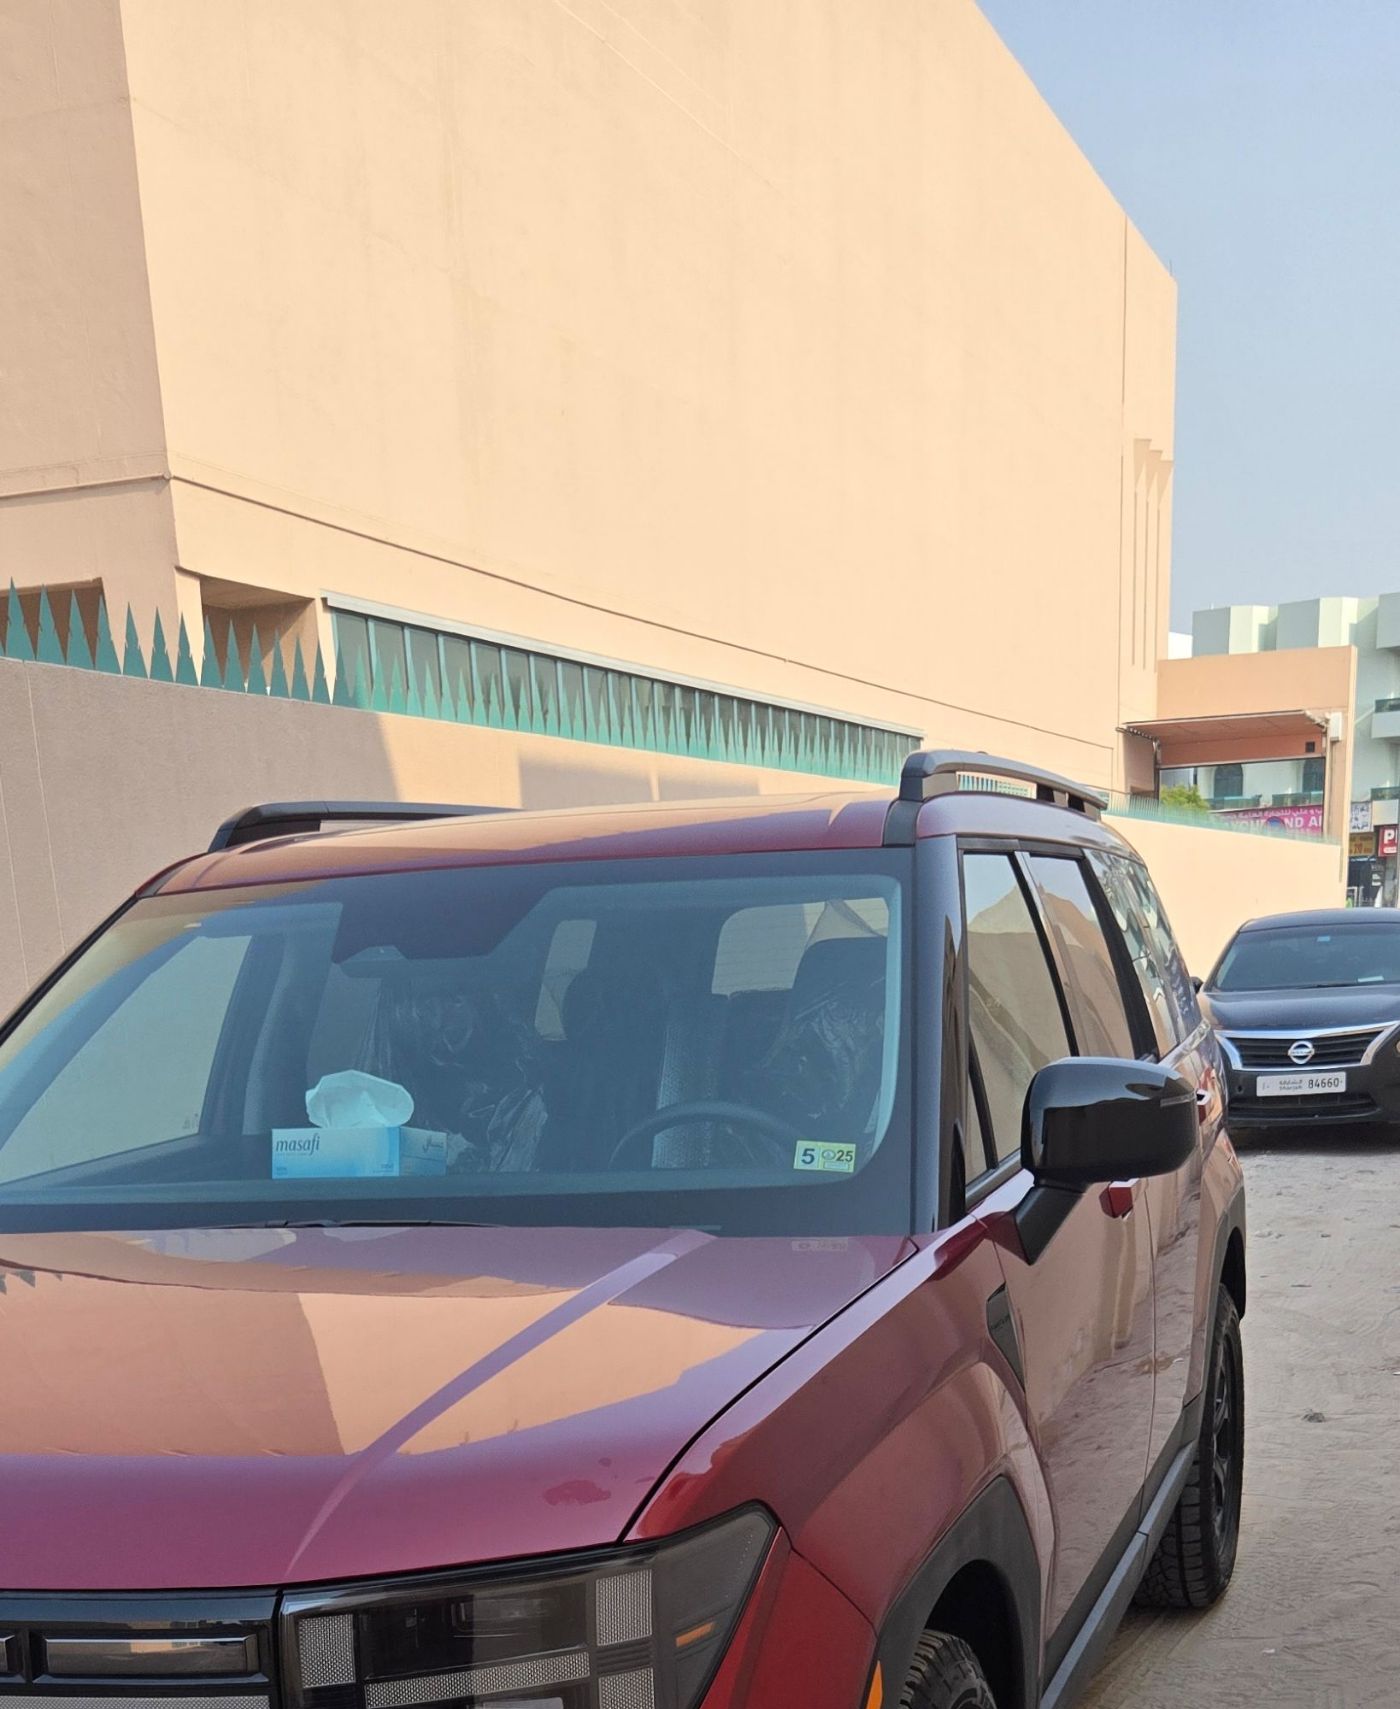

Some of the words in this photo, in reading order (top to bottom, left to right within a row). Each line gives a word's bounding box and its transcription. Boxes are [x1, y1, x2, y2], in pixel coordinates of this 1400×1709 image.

[1308, 1077, 1340, 1089] 84660
[275, 1132, 320, 1155] masafi
[801, 1148, 815, 1164] 5
[835, 1150, 853, 1162] 25
